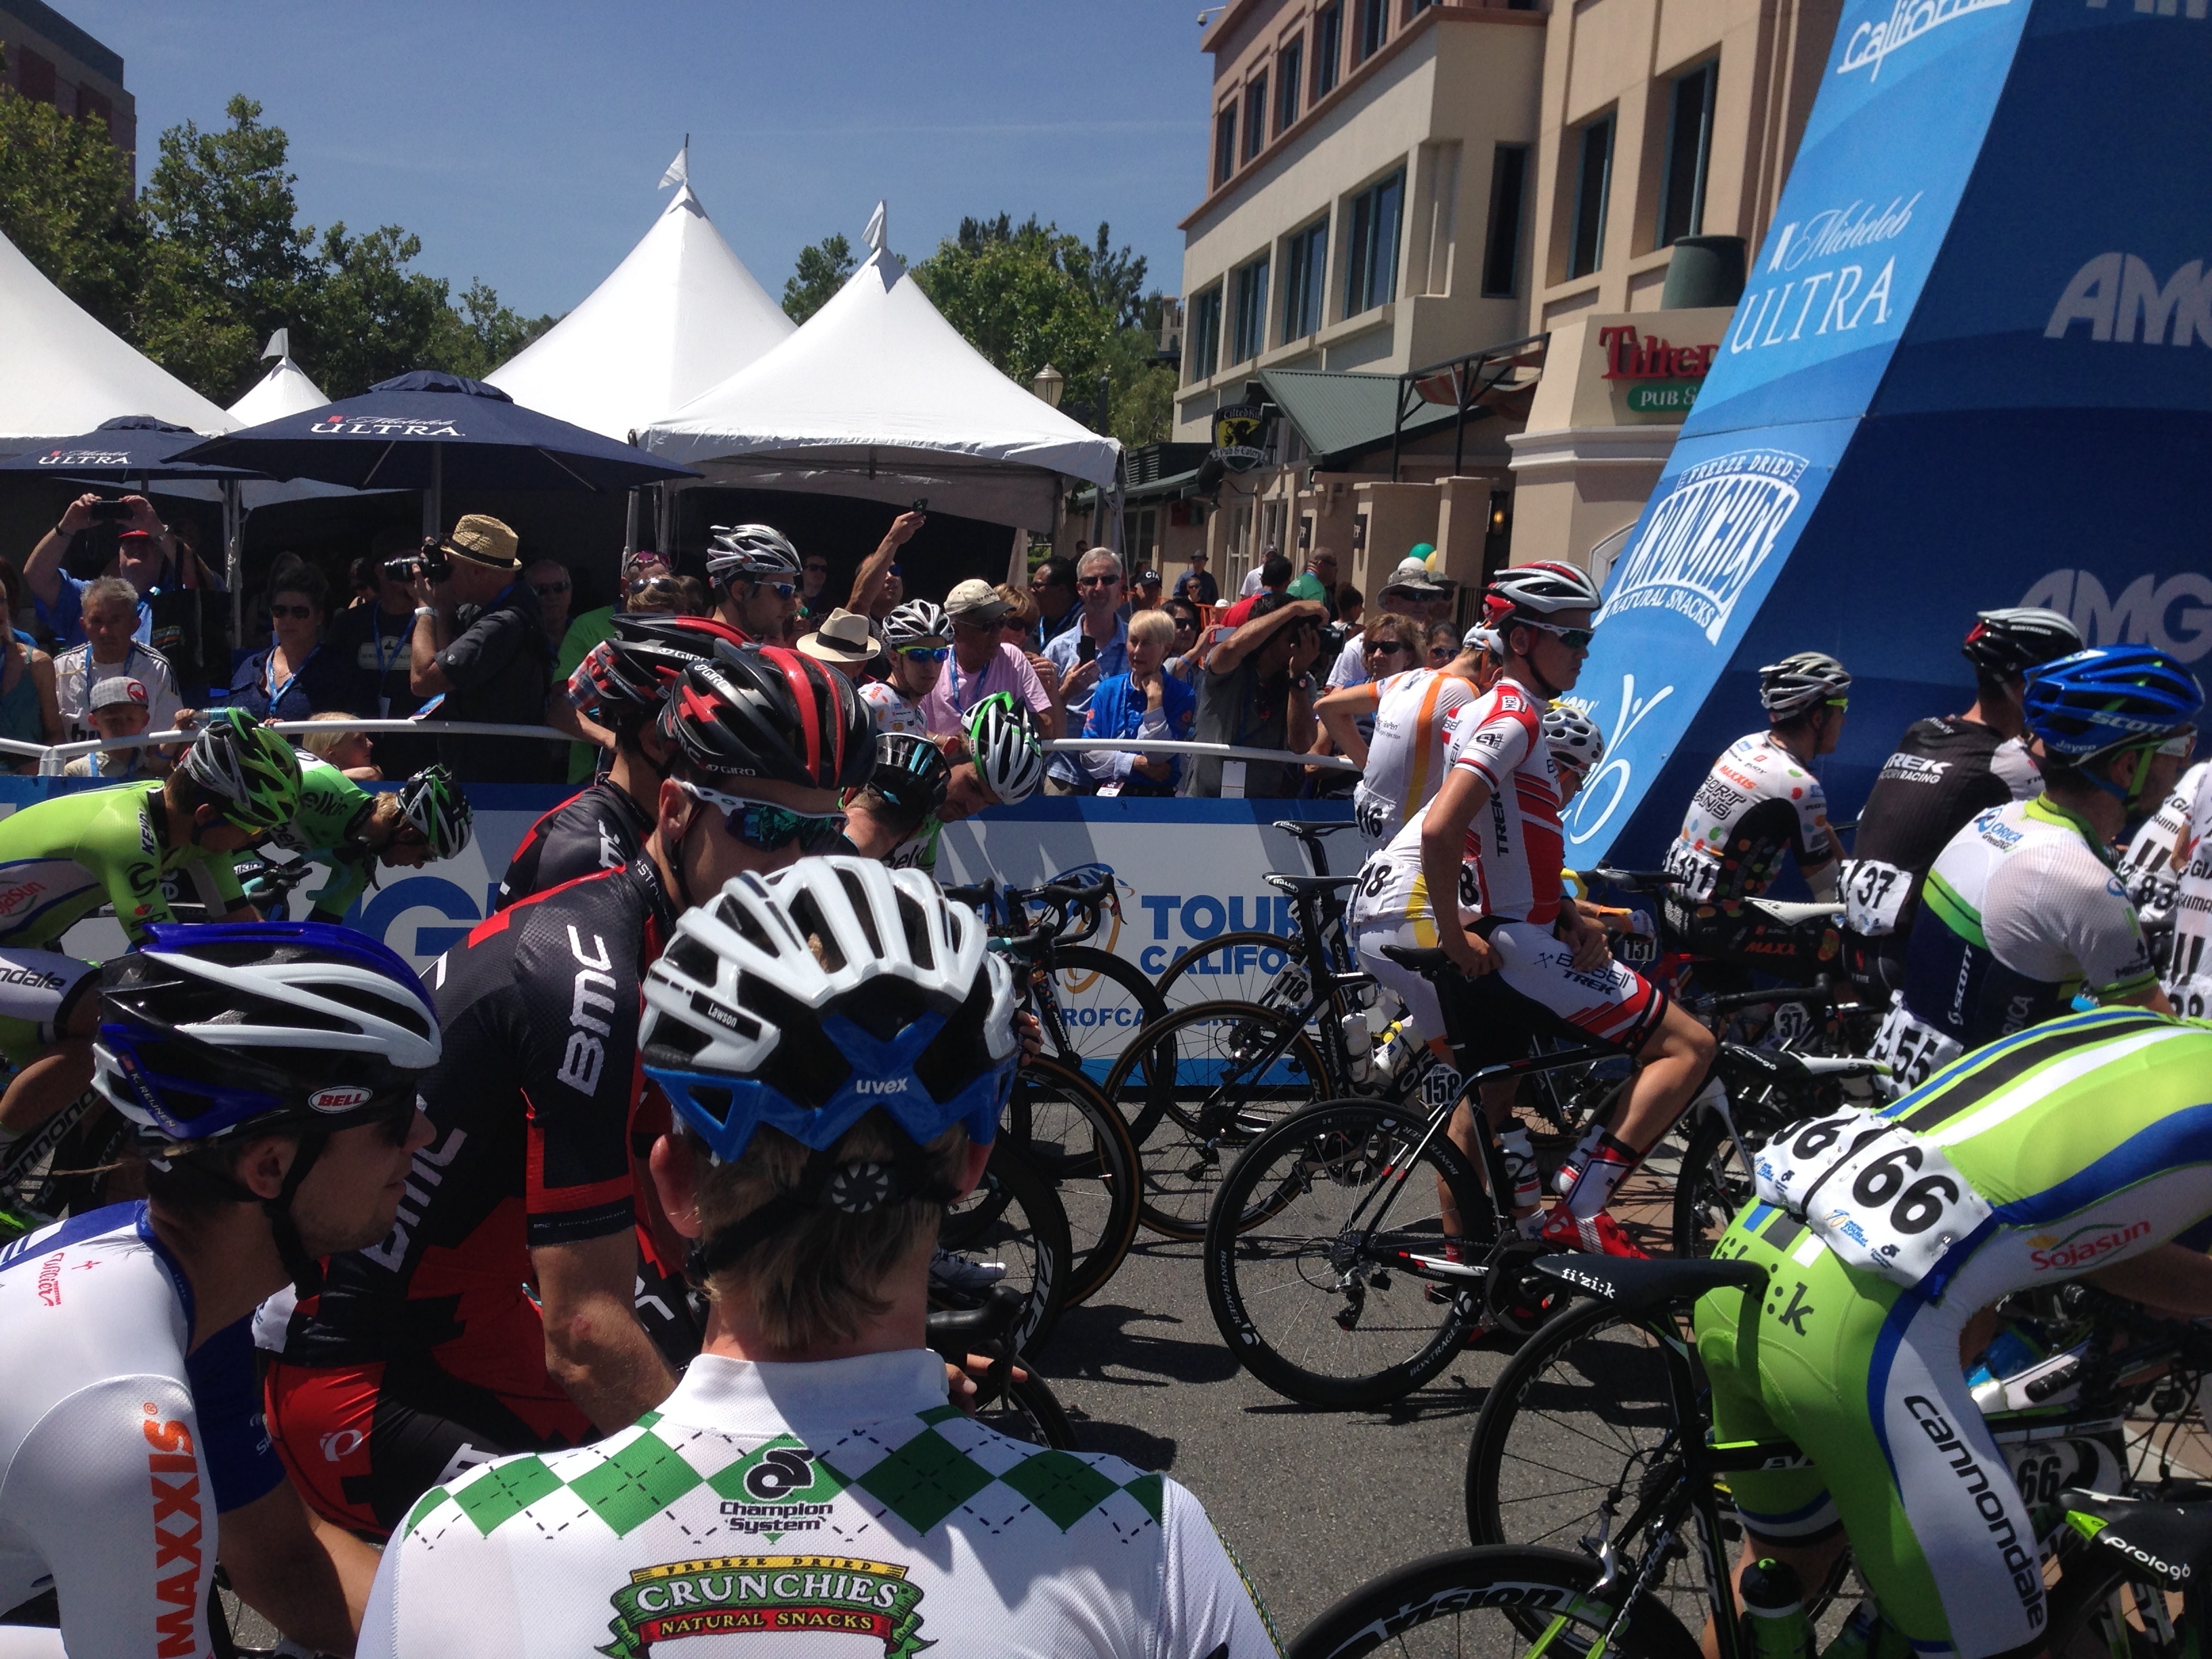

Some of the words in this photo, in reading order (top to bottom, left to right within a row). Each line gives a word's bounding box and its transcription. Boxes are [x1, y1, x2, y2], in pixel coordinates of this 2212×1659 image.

[1730, 255, 1896, 354] ULTRA
[1640, 390, 1679, 407] PUB
[310, 422, 462, 436] ULTRA
[39, 455, 131, 464] ULTRA
[1687, 456, 1744, 483] FREEZE
[1749, 455, 1795, 478] DRIED
[1145, 571, 1160, 581] CIA
[1606, 587, 1667, 618] NATURAL
[1665, 588, 1715, 629] SNACKS
[702, 667, 731, 691] GIRO
[720, 766, 756, 776] GIRO
[1719, 764, 1758, 790] MAXXIS
[1900, 770, 1941, 785] RACING
[138, 807, 156, 857] KEND
[1356, 806, 1383, 838] 116
[1490, 790, 1509, 858] TREK
[1992, 821, 2024, 843] ORICA
[1355, 862, 1392, 898] 18
[1858, 866, 1898, 909] 37
[1274, 970, 1309, 1004] 118
[1563, 968, 1617, 996] TREK
[1954, 945, 1972, 1011] SCOTT
[557, 924, 617, 1098] BMC
[708, 1002, 737, 1028] Lawson
[1780, 1012, 1804, 1038] 37
[1326, 1023, 1340, 1077] ORBEA
[1891, 1025, 1931, 1088] 55
[318, 1094, 364, 1107] BELL
[855, 1077, 909, 1095] uvex
[1426, 1073, 1462, 1106] 158
[1852, 1145, 1960, 1235] 66
[2030, 1221, 2152, 1272] Sojasun
[1219, 1249, 1242, 1326] BONTRAGER
[720, 1501, 834, 1519] Champion
[729, 1517, 821, 1534] System
[1904, 1395, 2045, 1630] cannondale
[143, 1418, 203, 1659] MAXXIS
[667, 1557, 768, 1575] FREEZE
[792, 1557, 873, 1570] DRIED
[2104, 1536, 2192, 1580] prologo
[636, 1572, 900, 1612] CRUNCHIES
[661, 1612, 765, 1635] NATURAL
[777, 1612, 872, 1630] SNACKS
